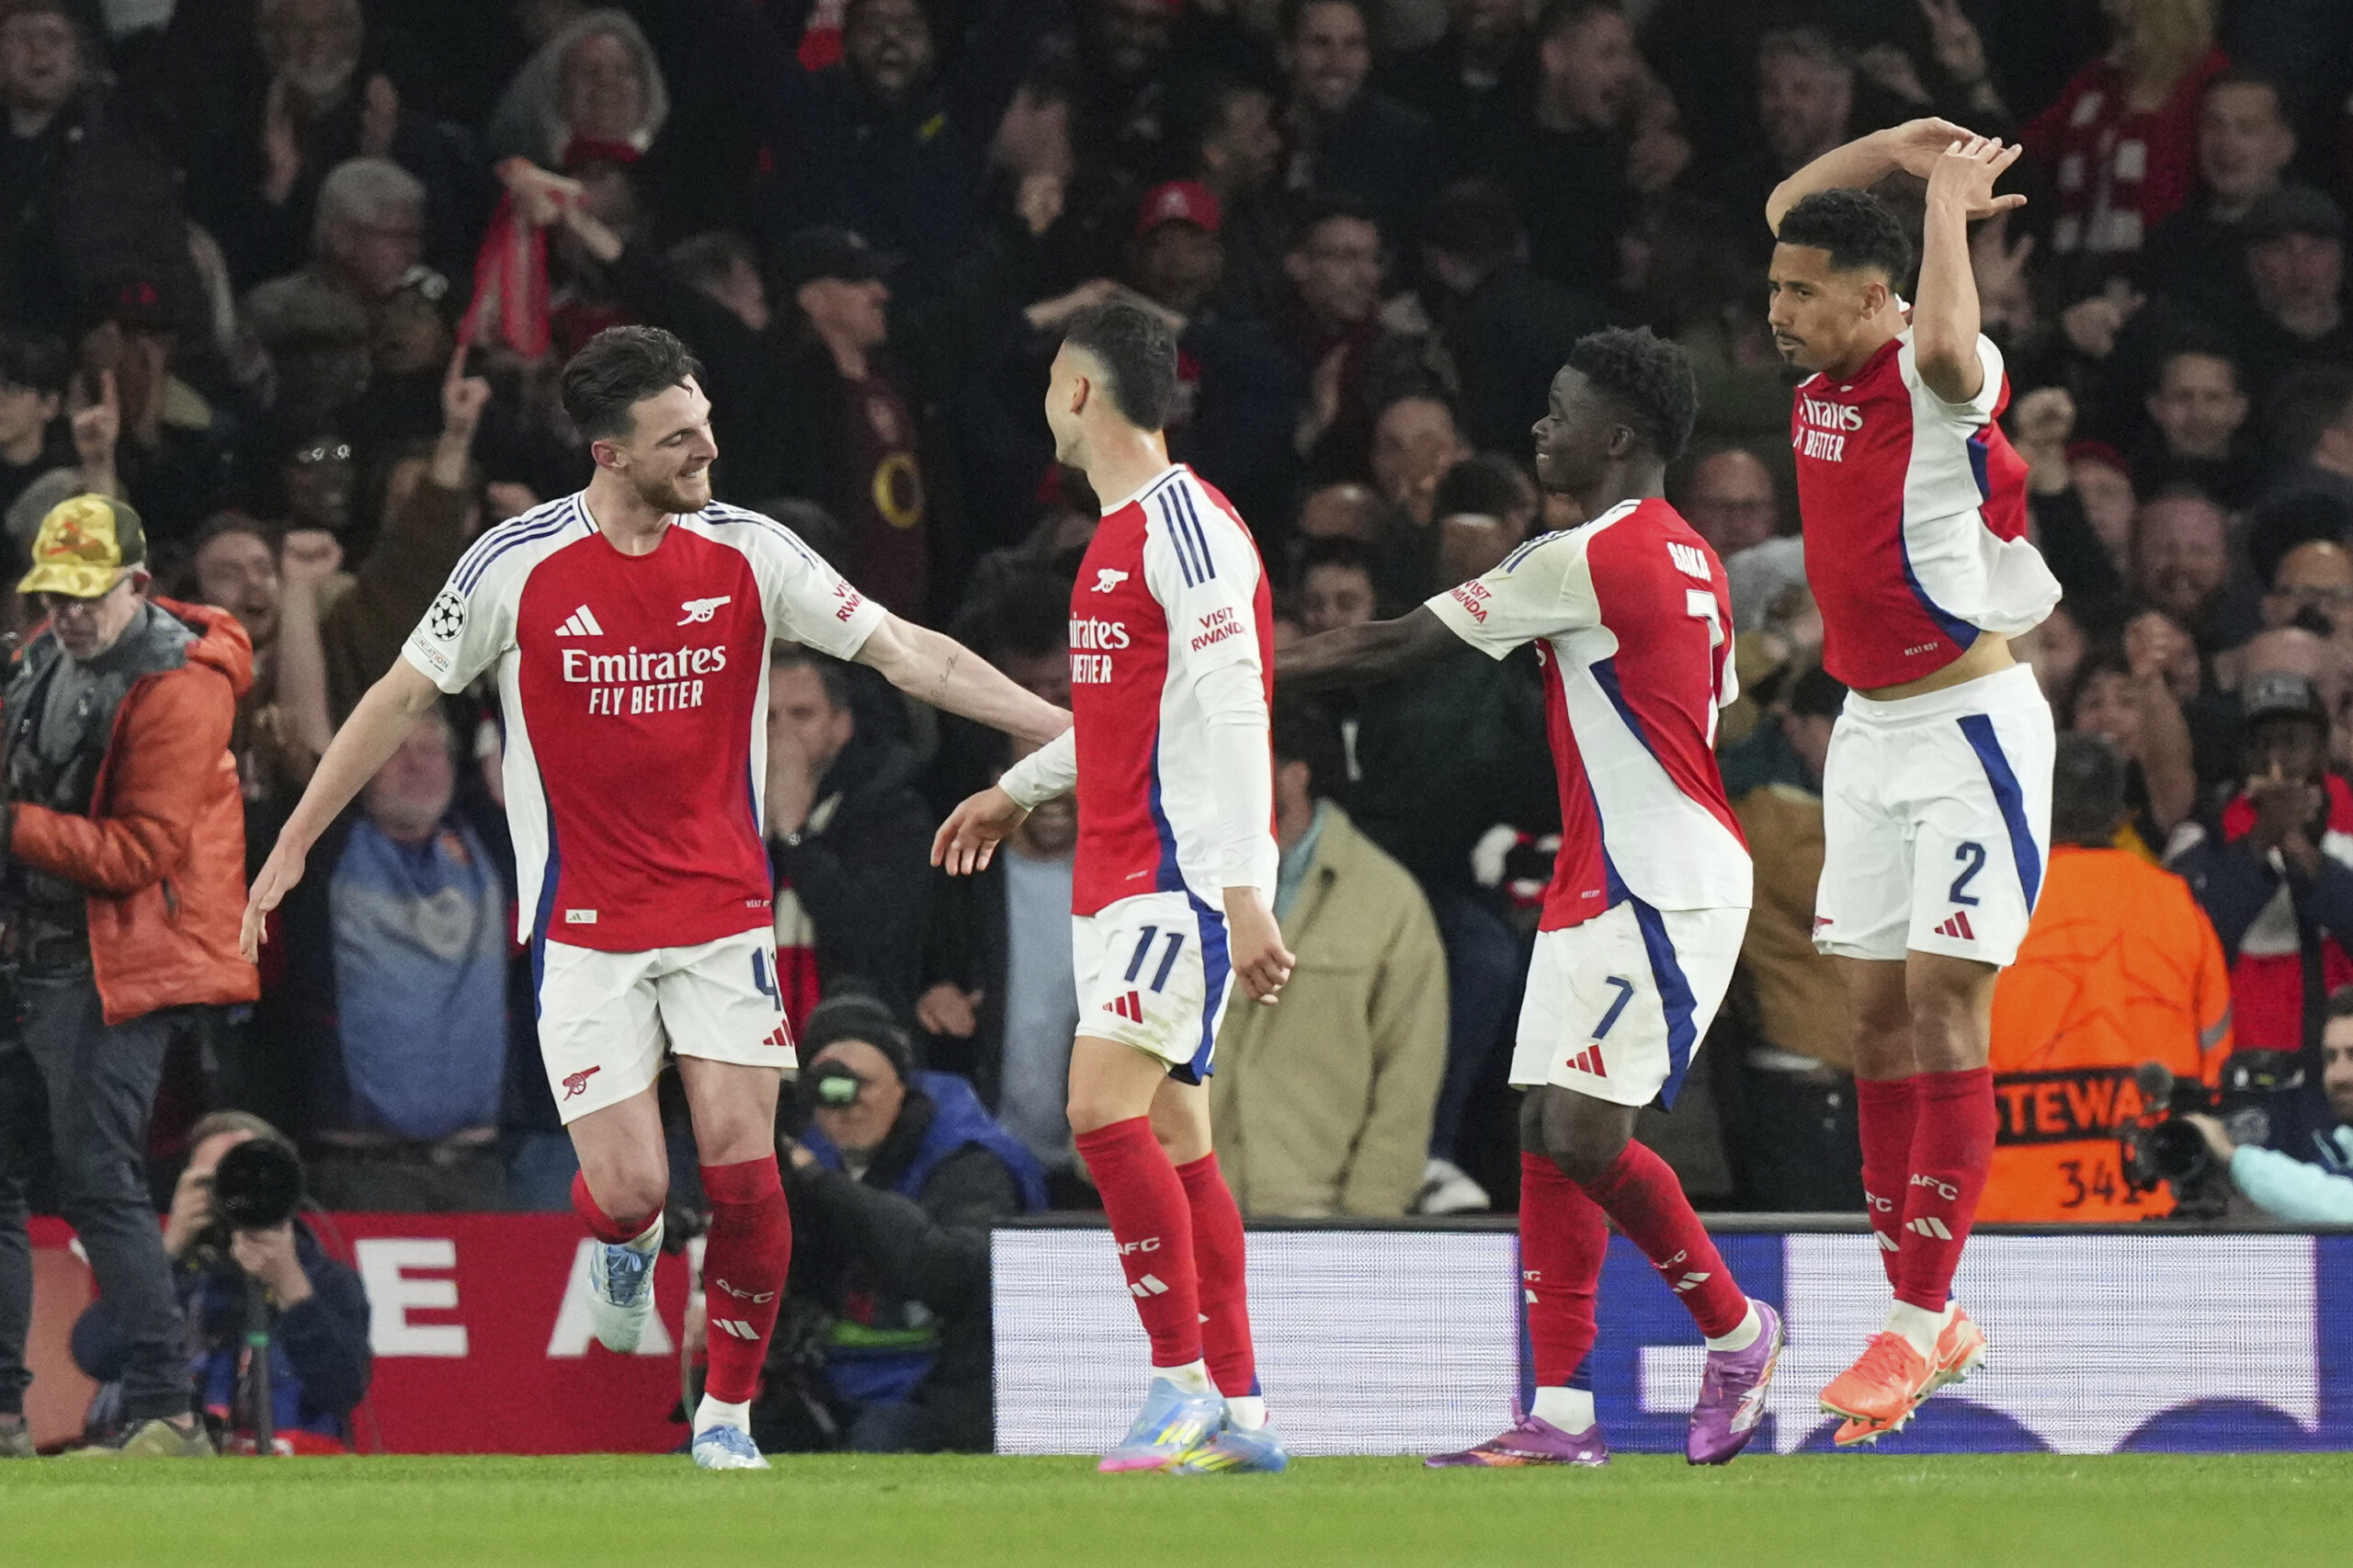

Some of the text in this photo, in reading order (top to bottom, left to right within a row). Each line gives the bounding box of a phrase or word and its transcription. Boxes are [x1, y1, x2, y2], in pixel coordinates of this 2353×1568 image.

[1800, 392, 1864, 432] irates
[1803, 429, 1845, 462] BETTER
[1666, 541, 1712, 582] SAKA
[833, 580, 852, 597] VIS
[1449, 588, 1487, 625] WANDA
[1465, 580, 1492, 600] VISIT
[1069, 610, 1131, 650] irates
[1199, 607, 1233, 629] VISIT
[561, 645, 727, 683] Emirates
[1072, 653, 1113, 684] BETTER
[588, 679, 704, 716] FLY BETTER
[1949, 841, 1986, 906] 2
[1123, 925, 1186, 994] 11
[750, 946, 782, 1012] 4
[1590, 974, 1635, 1040] 7
[1996, 1075, 2146, 1136] TEWA
[1865, 1190, 1893, 1212] FC
[1910, 1173, 1959, 1201] AFC
[715, 1278, 775, 1304] AFC
